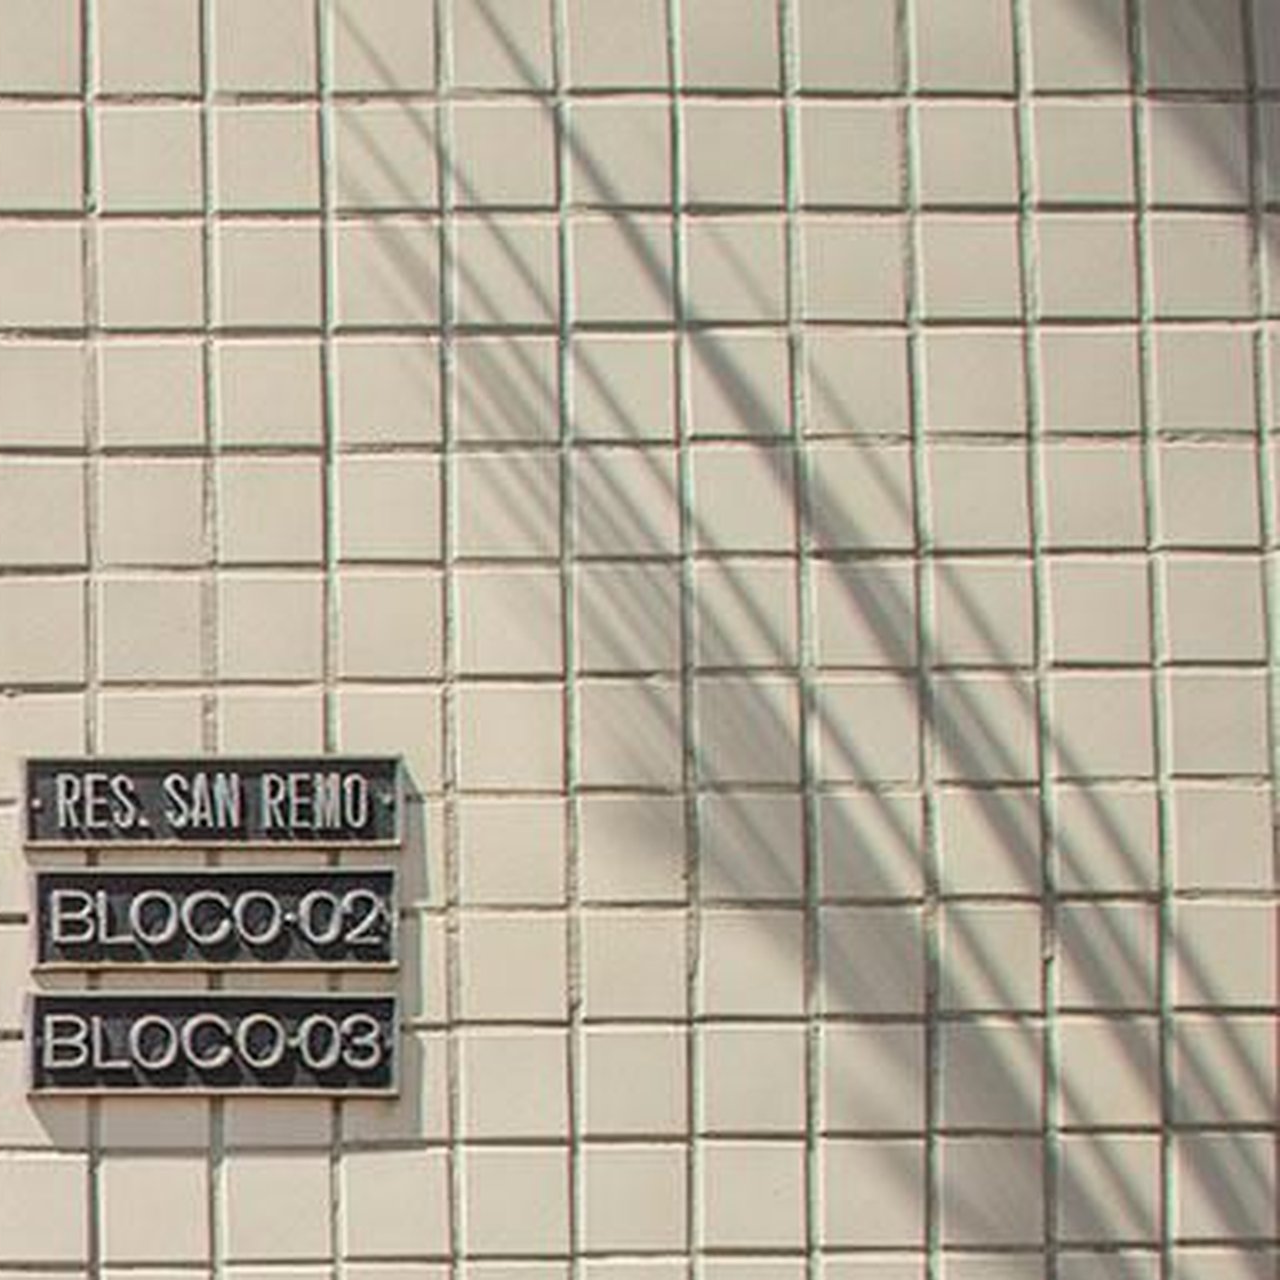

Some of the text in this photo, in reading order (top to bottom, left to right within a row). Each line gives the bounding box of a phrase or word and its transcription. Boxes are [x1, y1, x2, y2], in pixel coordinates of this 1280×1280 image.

[57, 773, 368, 829] RES. SAN REMO
